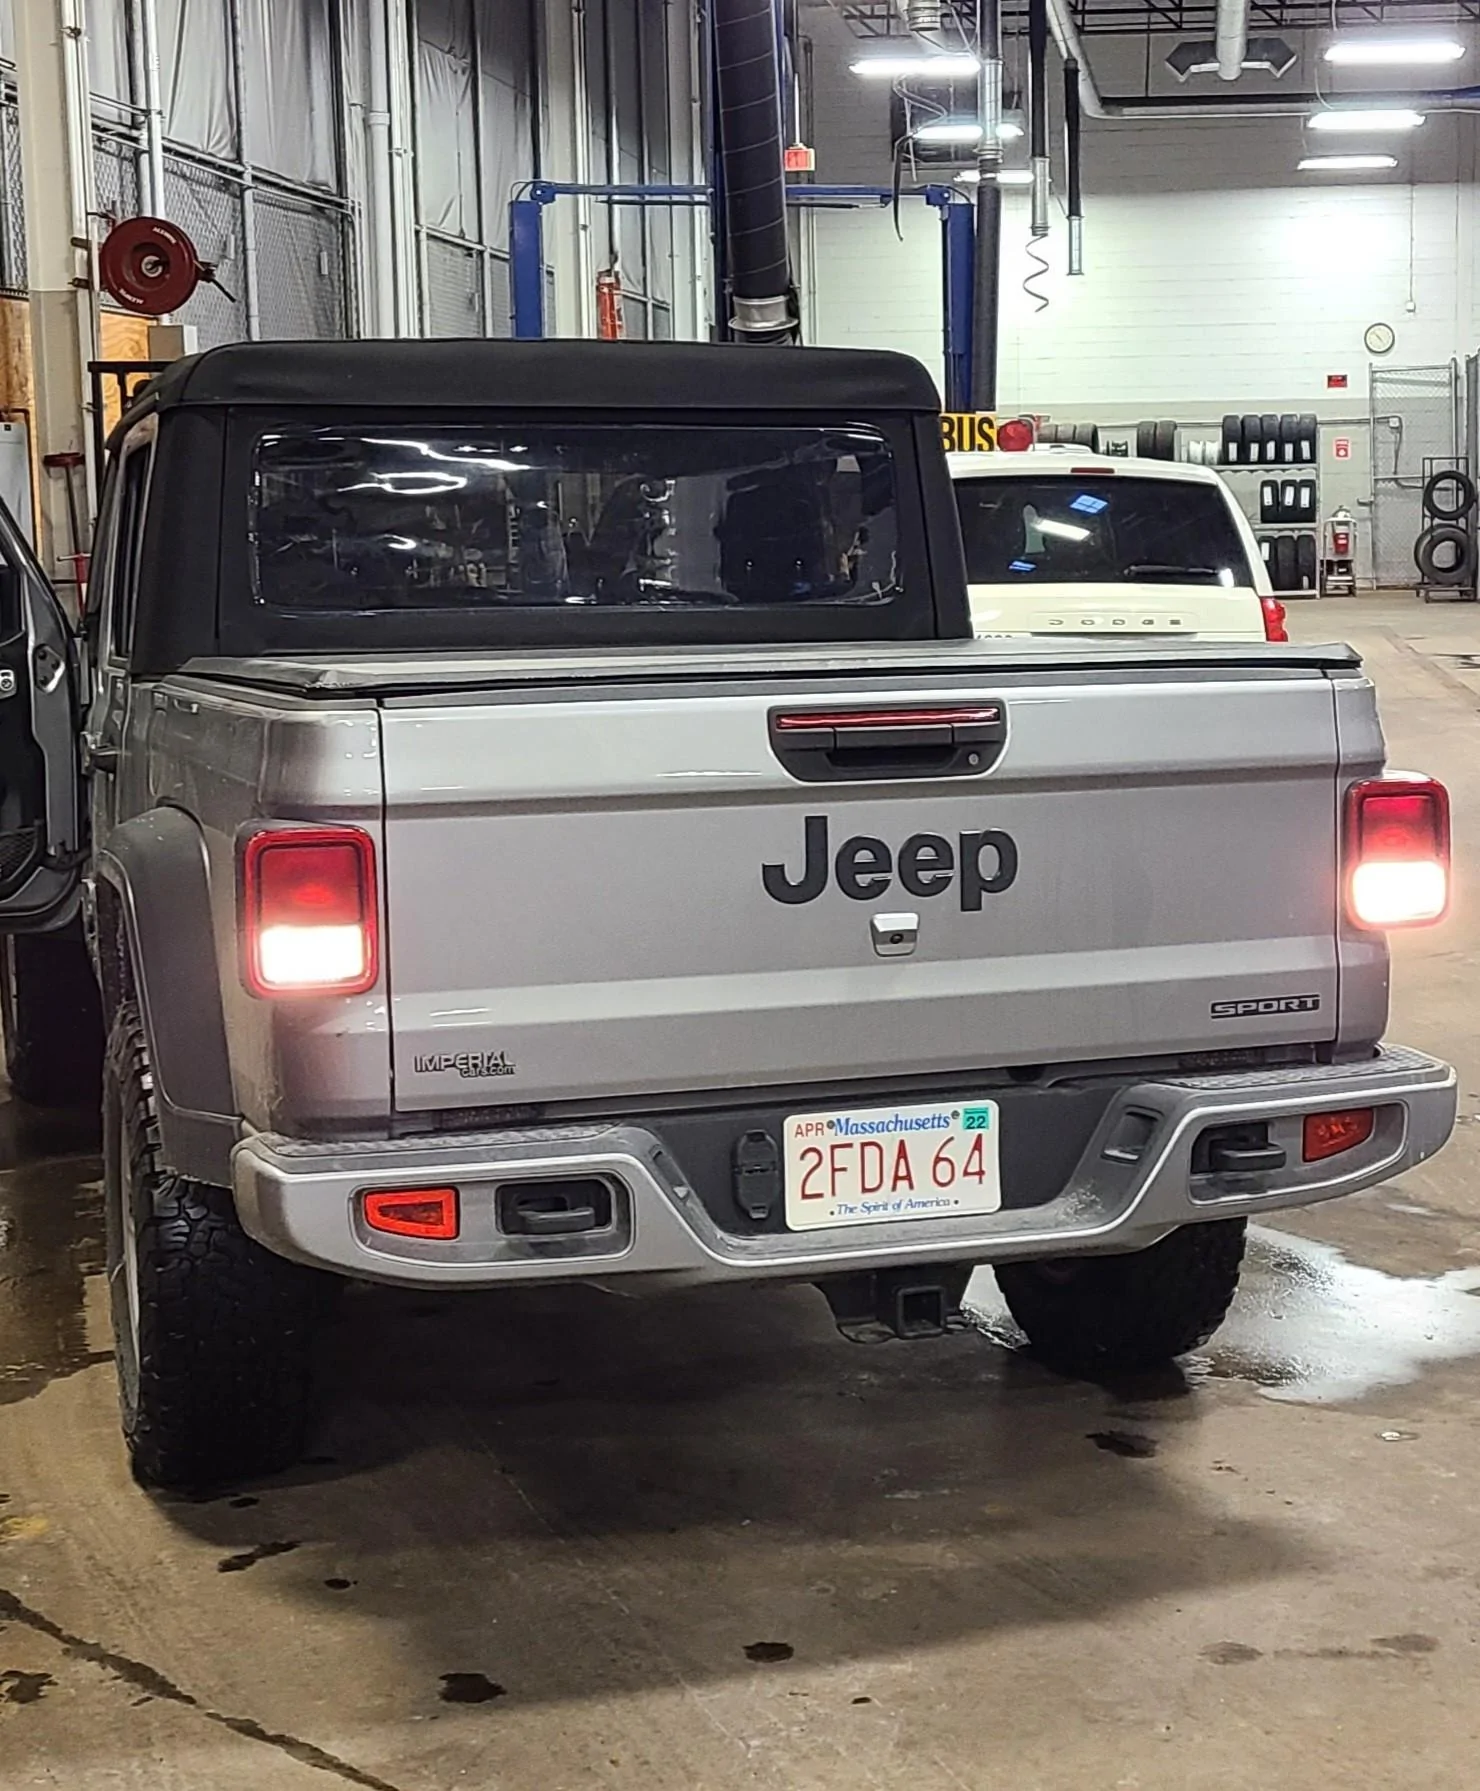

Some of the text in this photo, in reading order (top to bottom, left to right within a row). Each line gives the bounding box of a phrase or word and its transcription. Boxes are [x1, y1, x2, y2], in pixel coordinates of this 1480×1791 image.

[940, 416, 995, 452] BUS
[762, 815, 1018, 912] Jeep
[1211, 997, 1320, 1018] SPORT
[414, 1051, 516, 1073] IMPERIAL
[460, 1066, 516, 1078] cars.com
[794, 1121, 825, 1139] APR
[834, 1113, 951, 1137] Massachusetts
[965, 1115, 987, 1131] 22
[799, 1132, 987, 1201] 2FDA 64
[837, 1196, 951, 1217] The Spirit of America
